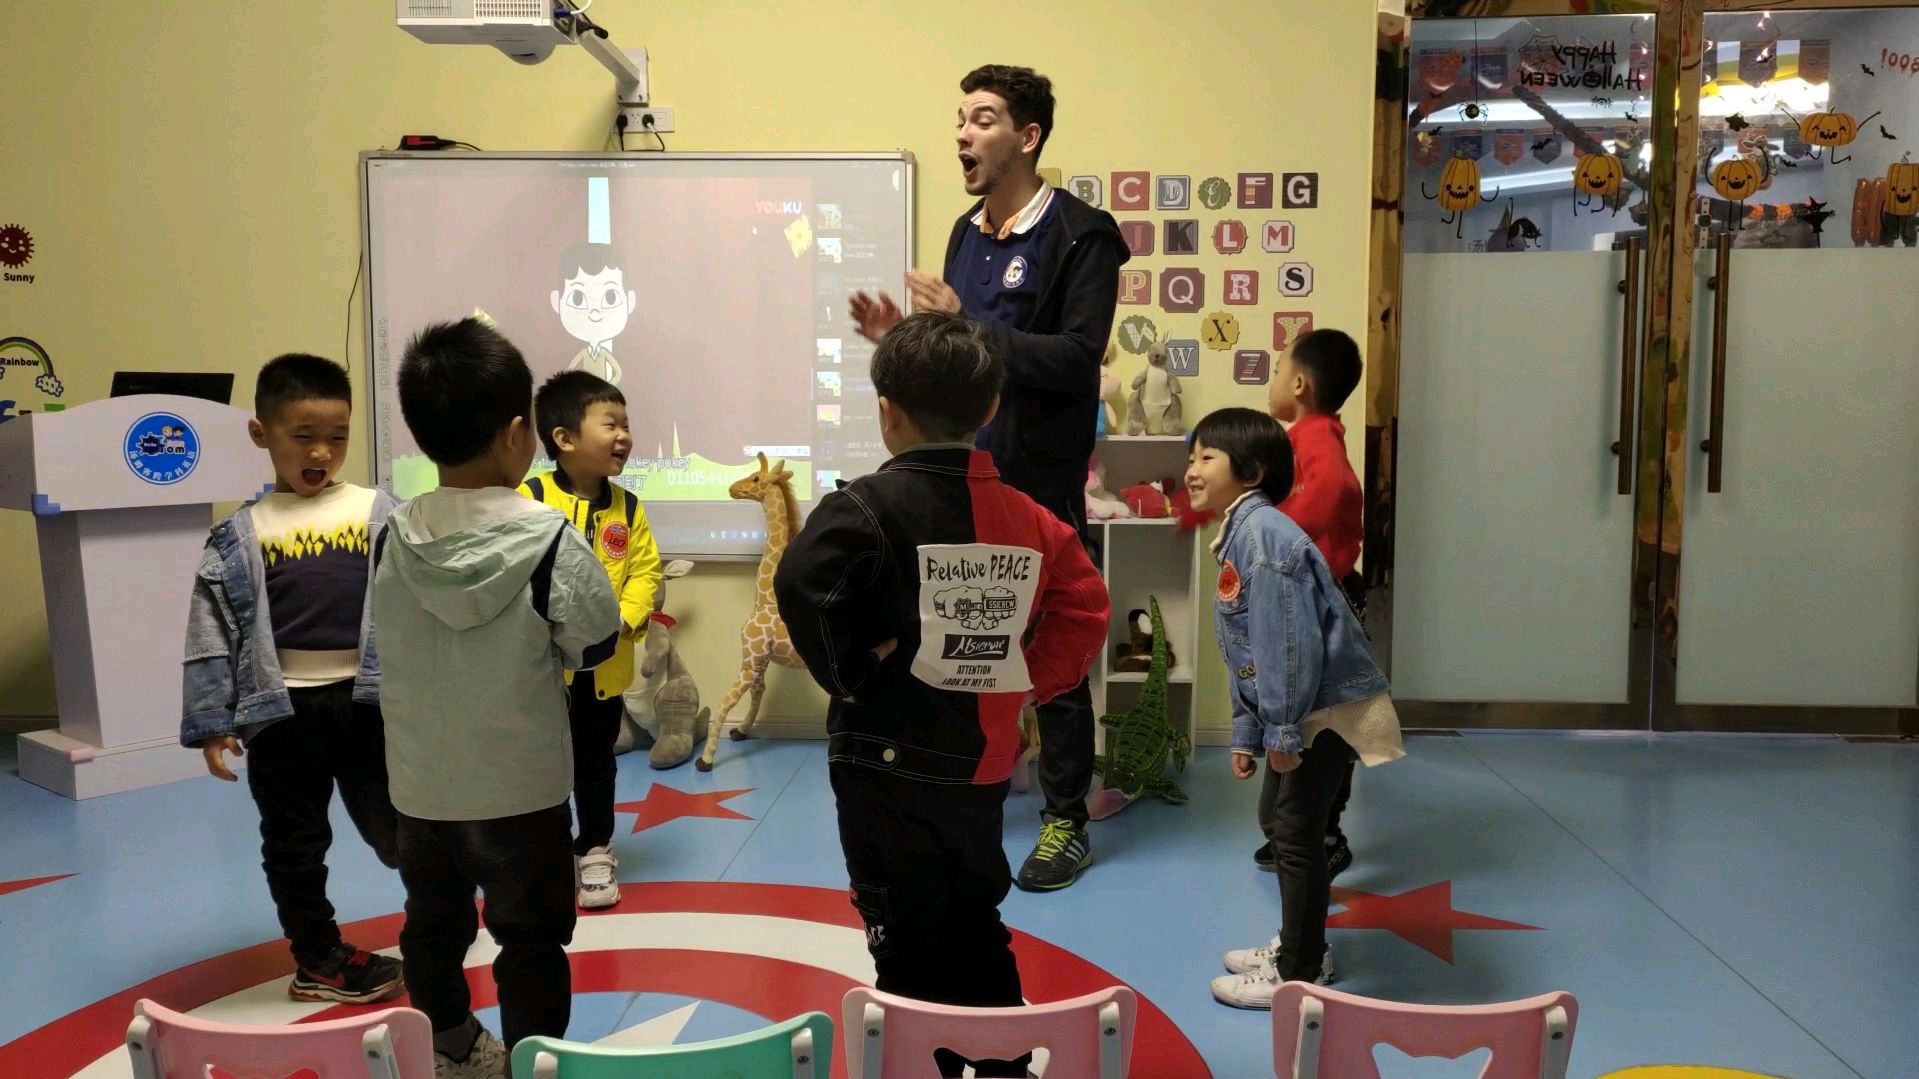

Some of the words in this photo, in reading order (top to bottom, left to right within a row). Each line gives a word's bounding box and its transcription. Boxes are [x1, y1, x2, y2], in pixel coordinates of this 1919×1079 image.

[1076, 180, 1095, 199] B
[1118, 177, 1142, 203] C
[1163, 180, 1184, 206] D
[1287, 176, 1311, 205] G
[754, 201, 802, 214] YOUKU
[1168, 222, 1194, 253] K
[1222, 224, 1238, 248] L
[1266, 225, 1290, 247] M
[4, 273, 35, 284] Sunny
[1122, 271, 1147, 301] P
[1168, 276, 1195, 304] Q
[1229, 274, 1251, 300] R
[1285, 267, 1306, 291] S
[1125, 322, 1154, 349] V
[1209, 319, 1231, 343] X
[0, 358, 39, 367] Rainbow
[1168, 347, 1194, 369] W
[656, 457, 690, 472] pokey
[927, 556, 987, 583] Relative
[990, 554, 1031, 584] PEACE
[957, 664, 992, 675] ATTENTION
[973, 679, 982, 687] MY
[984, 678, 996, 688] FIST
